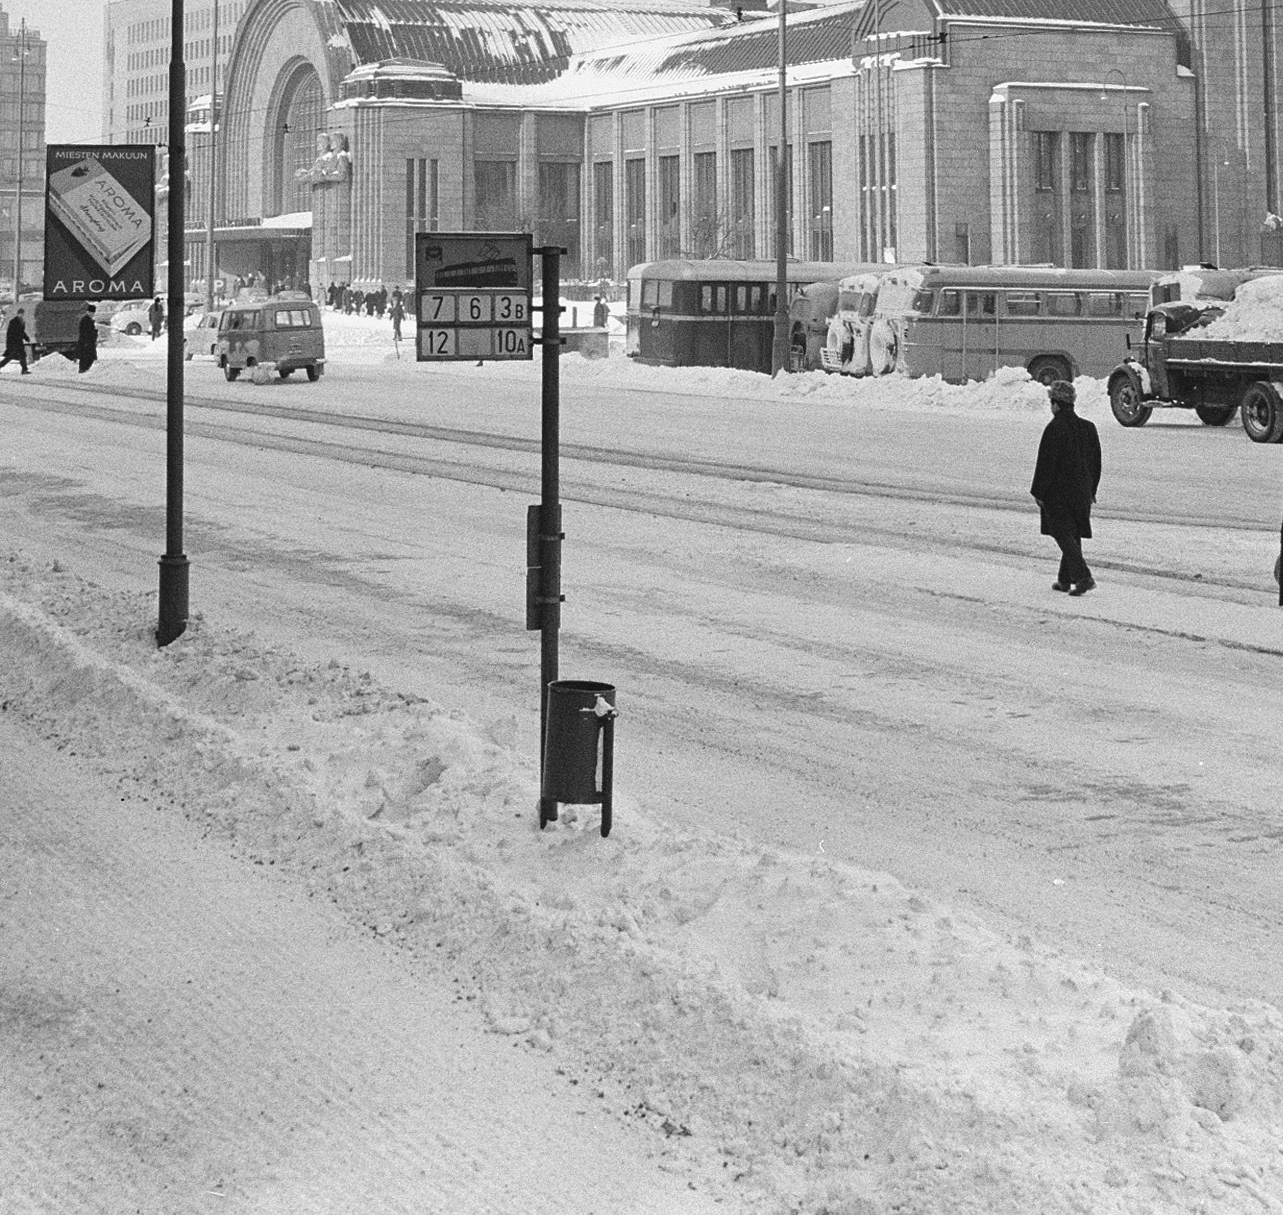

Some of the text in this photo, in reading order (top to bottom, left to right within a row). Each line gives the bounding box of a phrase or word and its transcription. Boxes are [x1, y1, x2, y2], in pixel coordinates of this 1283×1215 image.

[55, 150, 148, 161] MIESTEN MAKUUN
[95, 179, 143, 230] AROMA
[52, 279, 144, 293] AROMA
[214, 279, 224, 289] P
[431, 296, 524, 320] 7 6 3B
[428, 329, 526, 354] 12 10A
